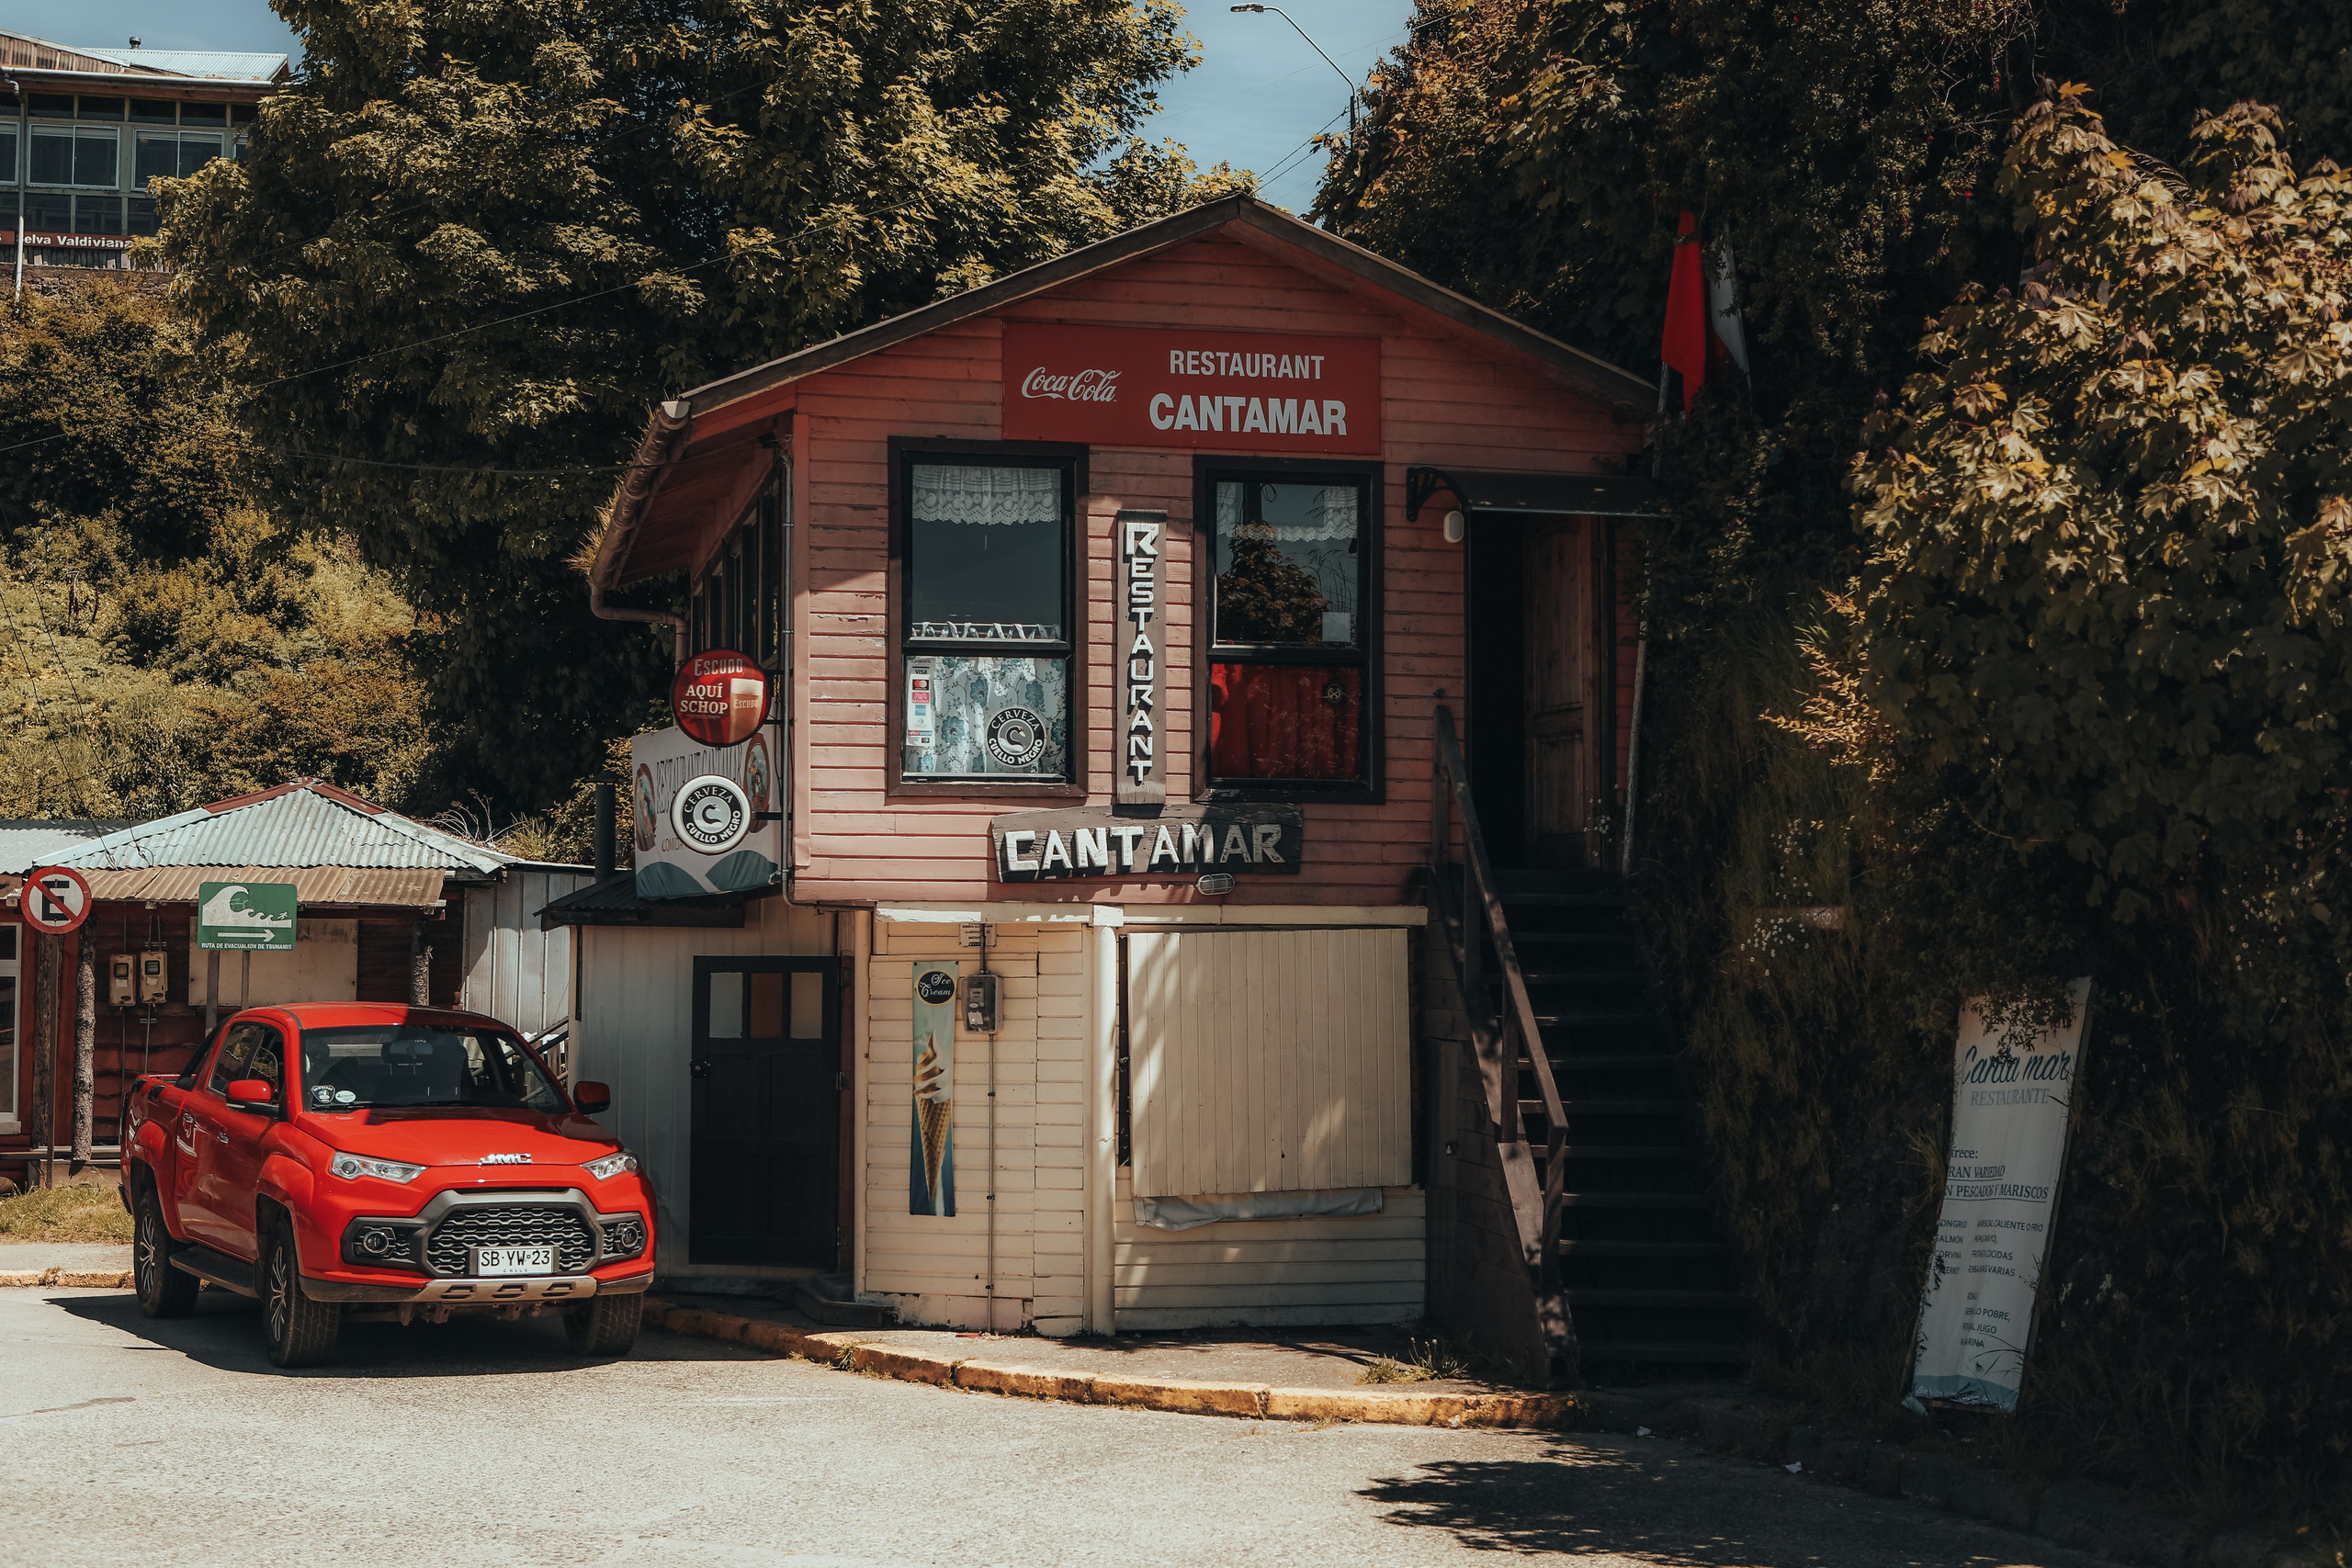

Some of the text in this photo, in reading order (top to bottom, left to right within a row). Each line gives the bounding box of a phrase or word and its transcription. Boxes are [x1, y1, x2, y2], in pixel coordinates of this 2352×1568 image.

[57, 235, 133, 248] Valdiviana
[1170, 350, 1324, 379] RESTAURANT
[1022, 367, 1122, 402] Coca-Cola
[1149, 393, 1347, 435] CANTAMAR
[1125, 522, 1159, 782] RESTAURANT
[685, 682, 723, 699] AQUÍ
[680, 700, 728, 714] SCHOP
[991, 709, 1040, 731] CERVEZA
[989, 738, 1043, 764] CUELLO NEGRO
[684, 786, 733, 813] CERVEZA
[685, 810, 741, 843] CUELLO NEGRO
[1005, 824, 1285, 871] CANTAMAR
[42, 881, 70, 920] E
[931, 973, 952, 986] Ice
[919, 981, 951, 998] Cream
[1971, 1088, 2050, 1107] RESTAURANTE
[481, 1154, 532, 1164] JMC
[1951, 1145, 1979, 1159] frece:
[1948, 1165, 2006, 1179] RAN VARIEDAD
[1957, 1184, 1994, 1197] PESCADOS
[1999, 1184, 2049, 1200] MARISCOS
[1994, 1219, 2025, 1231] CALIENTE
[1988, 1265, 2016, 1278] VARIAS
[1983, 1308, 2011, 1323] POBRE,
[1977, 1324, 1997, 1334] JUGO
